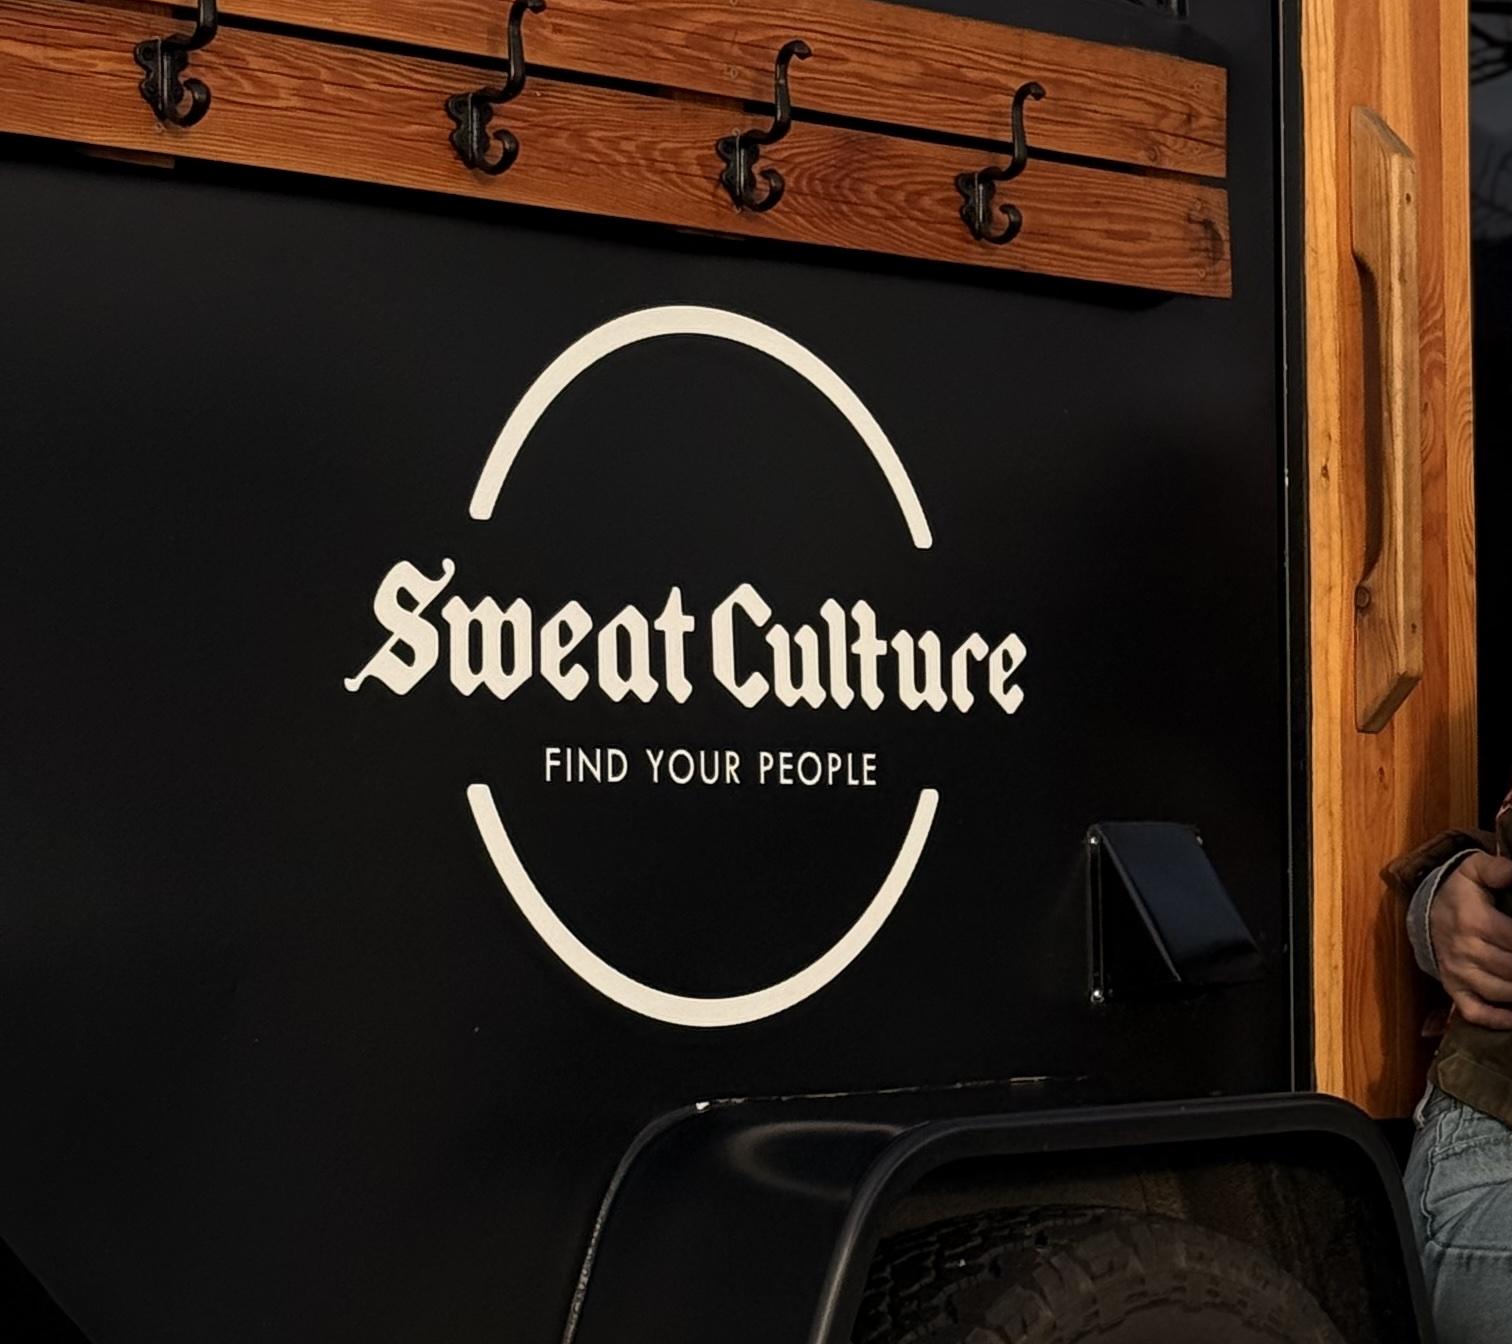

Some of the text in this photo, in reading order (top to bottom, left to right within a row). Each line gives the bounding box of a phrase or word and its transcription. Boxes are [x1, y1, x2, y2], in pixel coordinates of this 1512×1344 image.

[343, 557, 1027, 715] Sweat Culture
[545, 747, 877, 786] FIND YOUR PEOPLE
